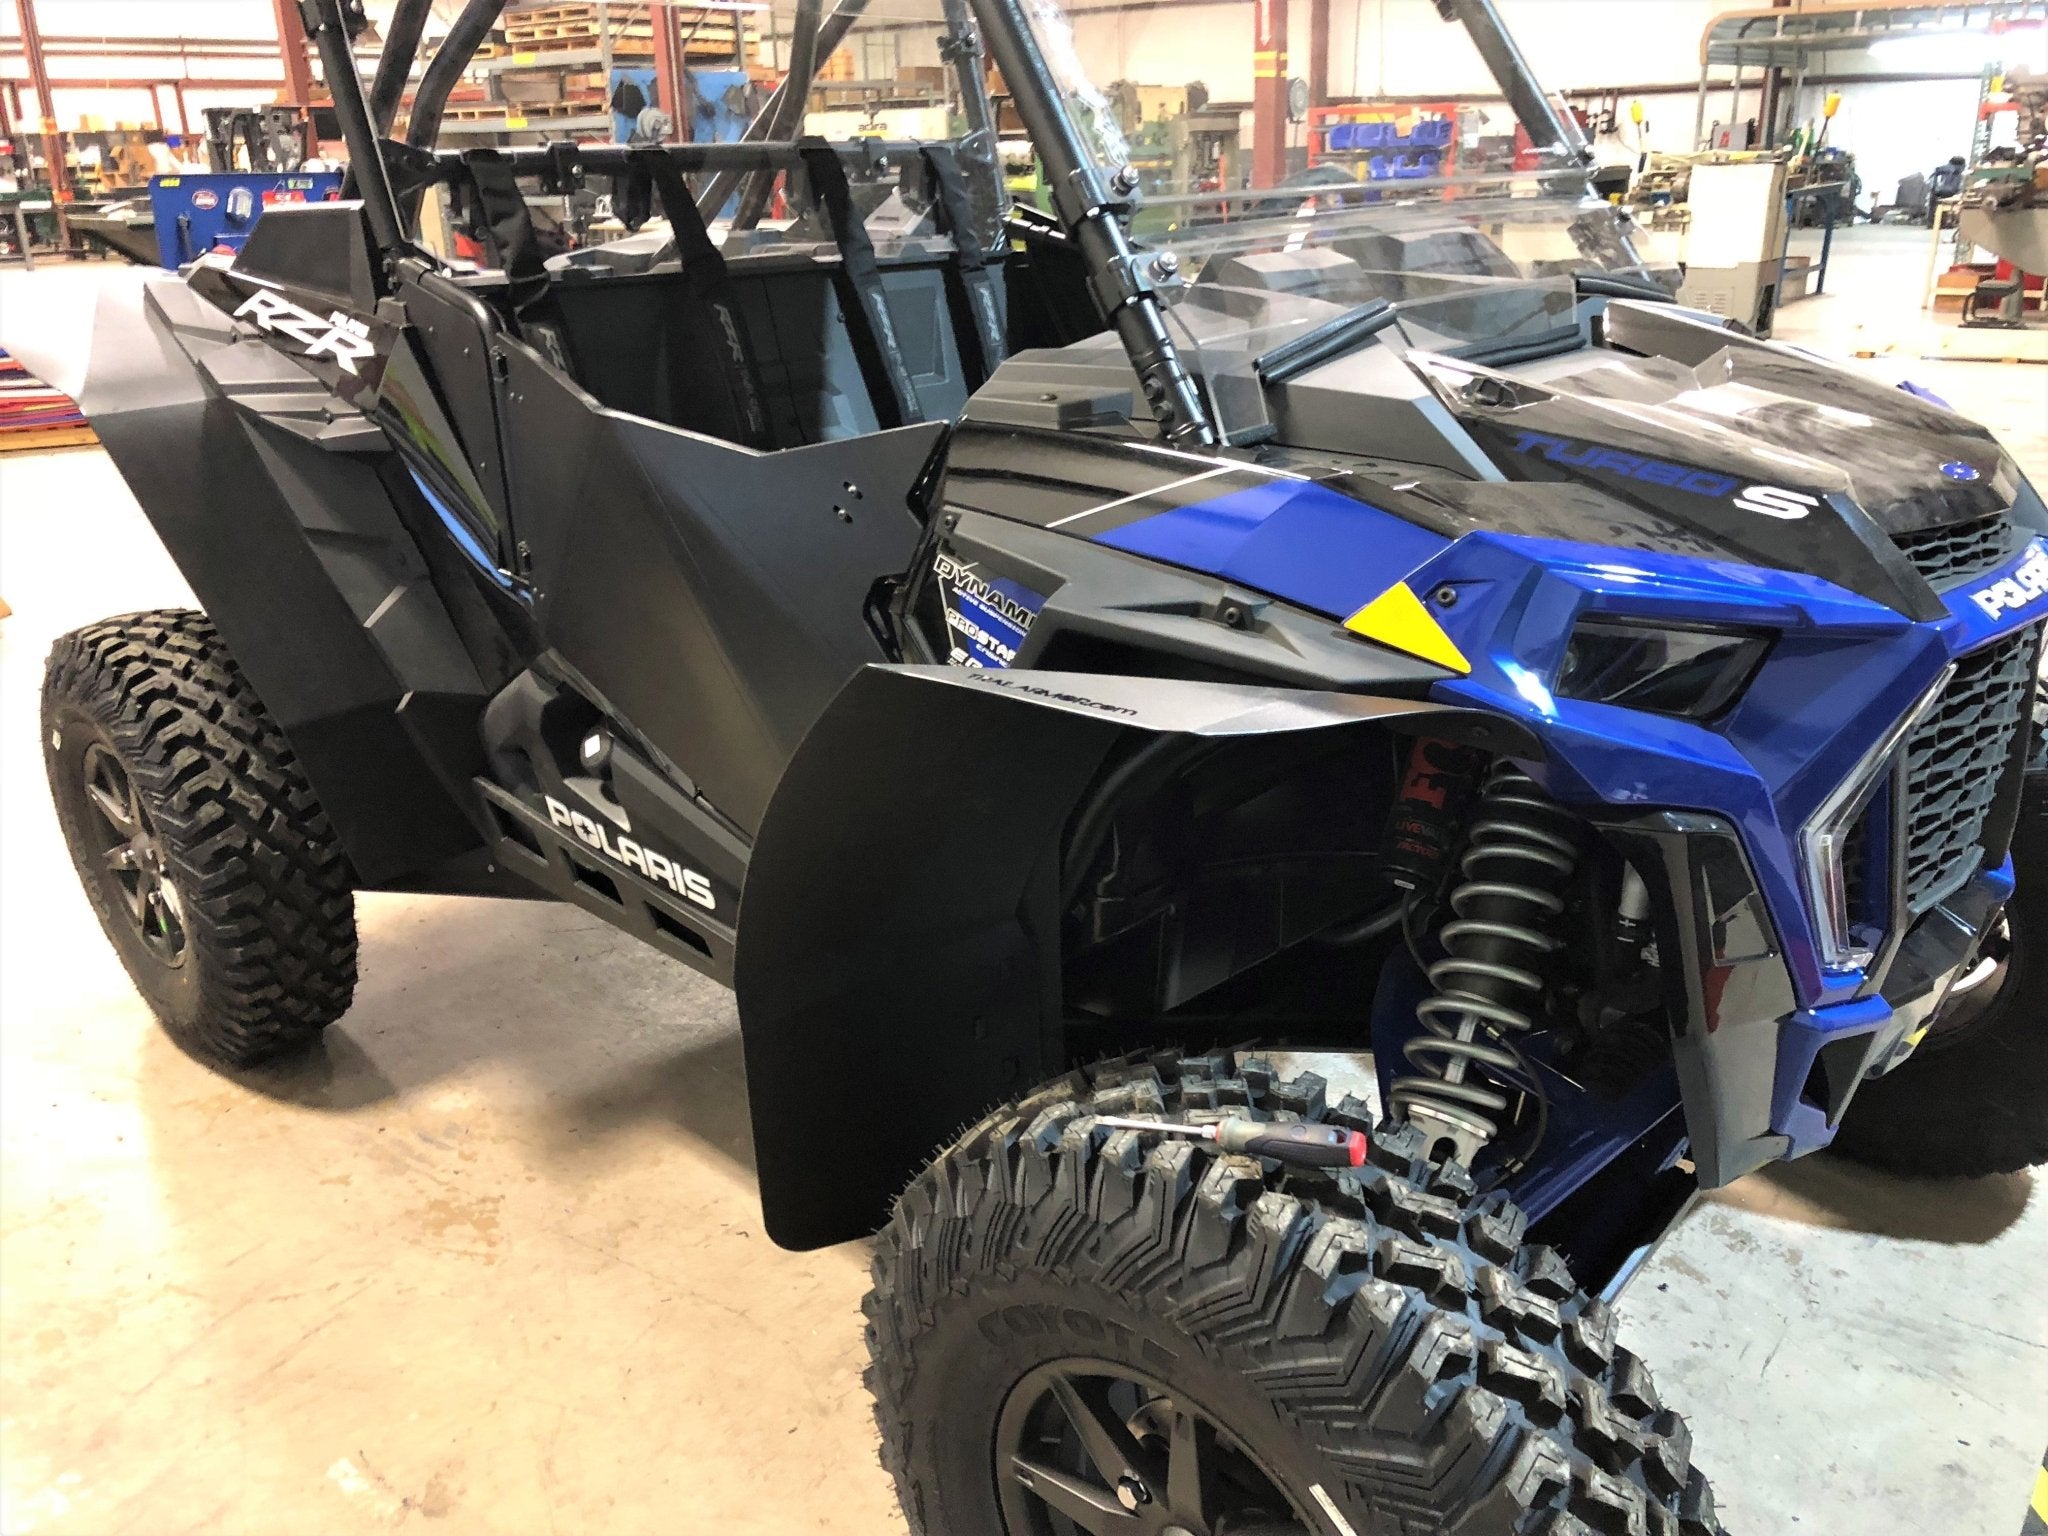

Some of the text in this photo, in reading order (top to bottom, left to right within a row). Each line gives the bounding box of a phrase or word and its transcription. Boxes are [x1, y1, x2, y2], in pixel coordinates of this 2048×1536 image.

[233, 288, 375, 376] RZR
[1515, 432, 1819, 519] TURBO S
[933, 554, 1037, 631] DYNAMI
[544, 795, 717, 910] POLARIS
